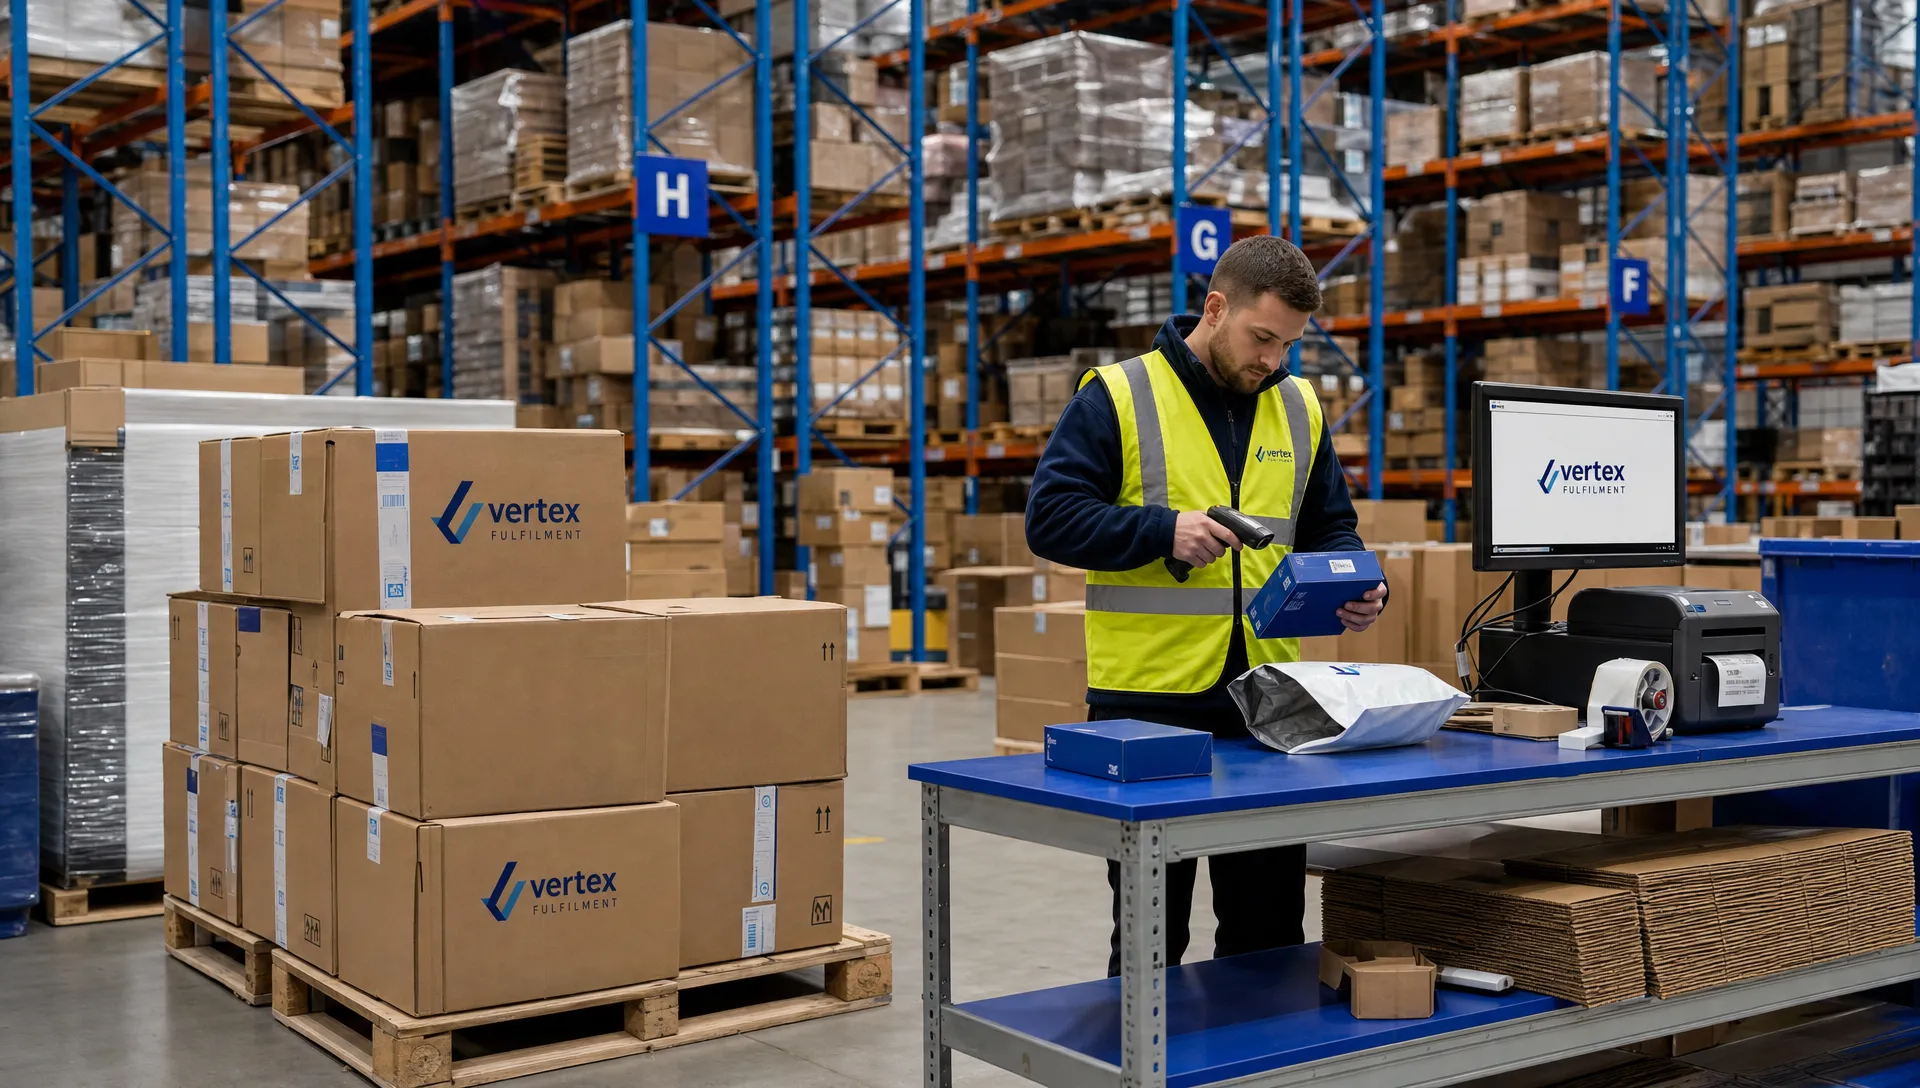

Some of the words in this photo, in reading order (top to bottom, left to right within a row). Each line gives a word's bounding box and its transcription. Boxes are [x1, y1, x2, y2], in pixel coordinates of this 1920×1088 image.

[656, 171, 690, 219] H
[1191, 219, 1219, 261] G
[1623, 267, 1641, 303] F
[1266, 449, 1293, 459] vertex
[1560, 461, 1625, 481] vertex
[1563, 486, 1626, 494] FULFILMENT
[488, 499, 581, 523] vertex
[491, 530, 582, 541] FULFILMENT
[530, 871, 617, 898] vertex
[533, 898, 618, 915] FULFILMENT
